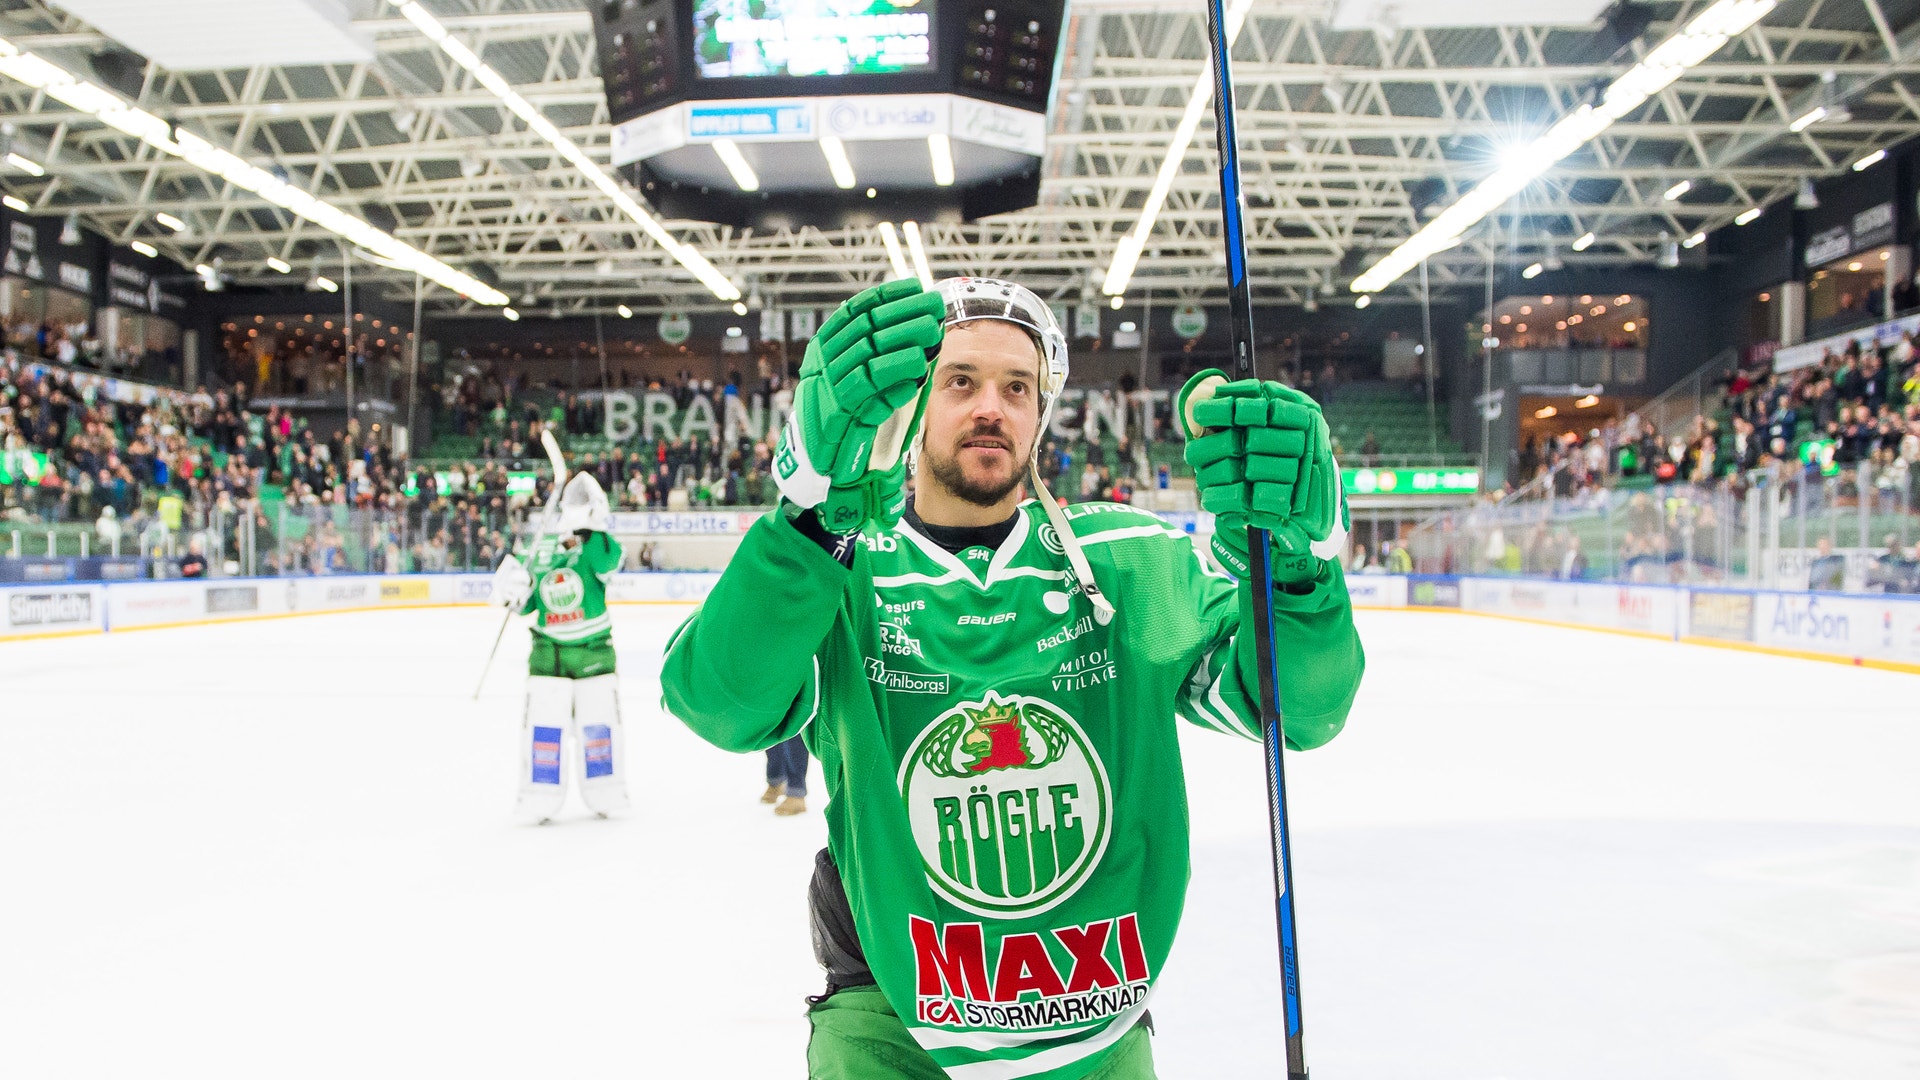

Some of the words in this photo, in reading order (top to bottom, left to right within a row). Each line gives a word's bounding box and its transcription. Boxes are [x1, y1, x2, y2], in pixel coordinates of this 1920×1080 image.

[864, 107, 936, 126] Lindab
[648, 513, 728, 530] Deloitte
[967, 549, 989, 562] SHL
[10, 592, 91, 624] Simplicity
[884, 599, 926, 614] esurs
[1771, 592, 1850, 640] AirSon
[957, 612, 1017, 626] BAUER
[881, 643, 912, 656] BYGG
[933, 784, 1085, 847] RÖGLE
[908, 911, 1150, 1003] MAXI
[918, 1000, 962, 1024] ICA
[966, 985, 1149, 1028] STORMARKNAD
